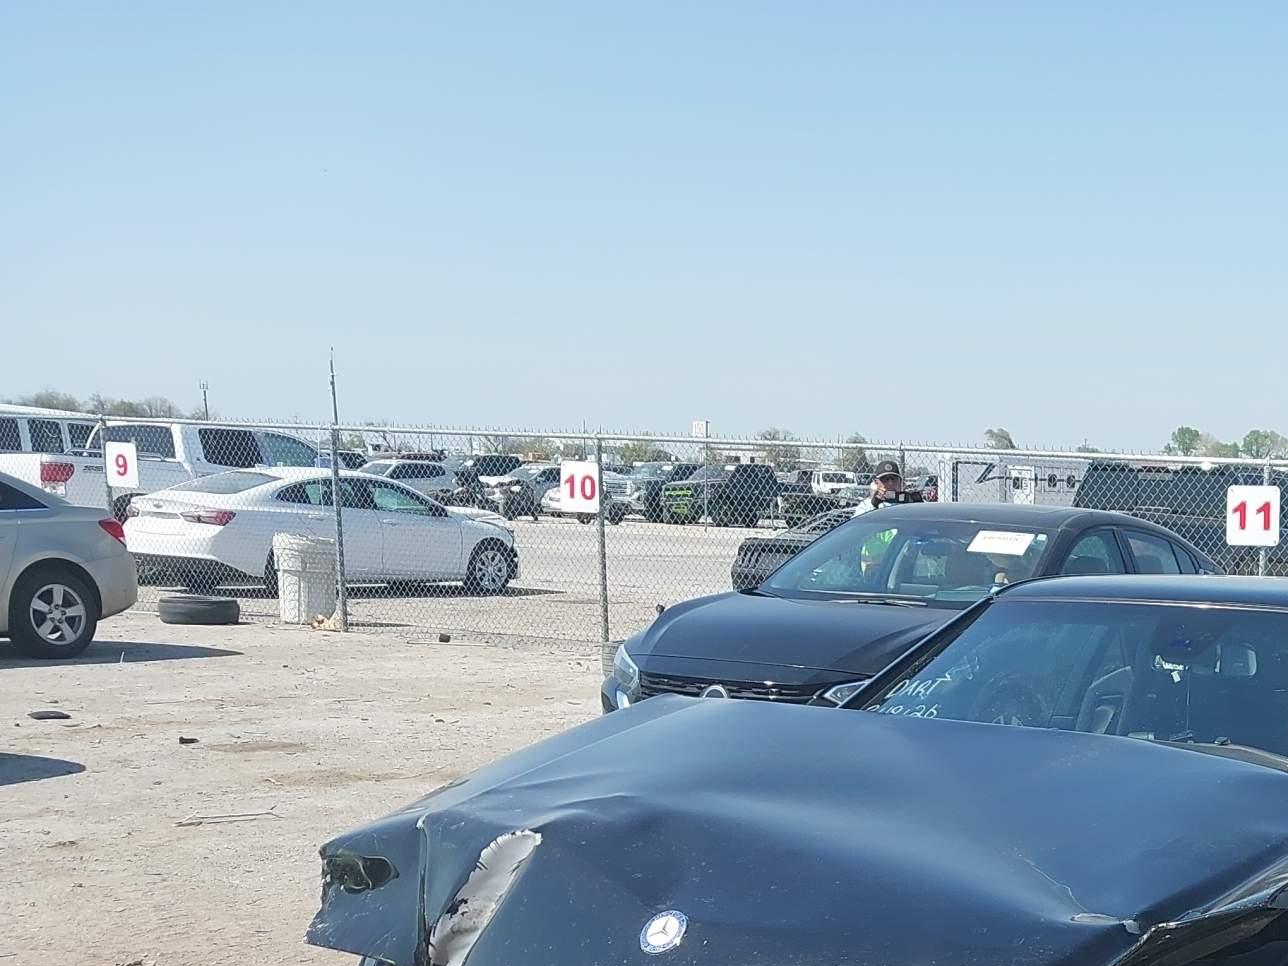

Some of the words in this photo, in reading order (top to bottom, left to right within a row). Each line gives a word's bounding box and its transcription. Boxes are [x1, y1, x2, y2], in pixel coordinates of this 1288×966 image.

[115, 454, 129, 476] 9
[565, 475, 597, 501] 10
[1232, 501, 1271, 531] 11
